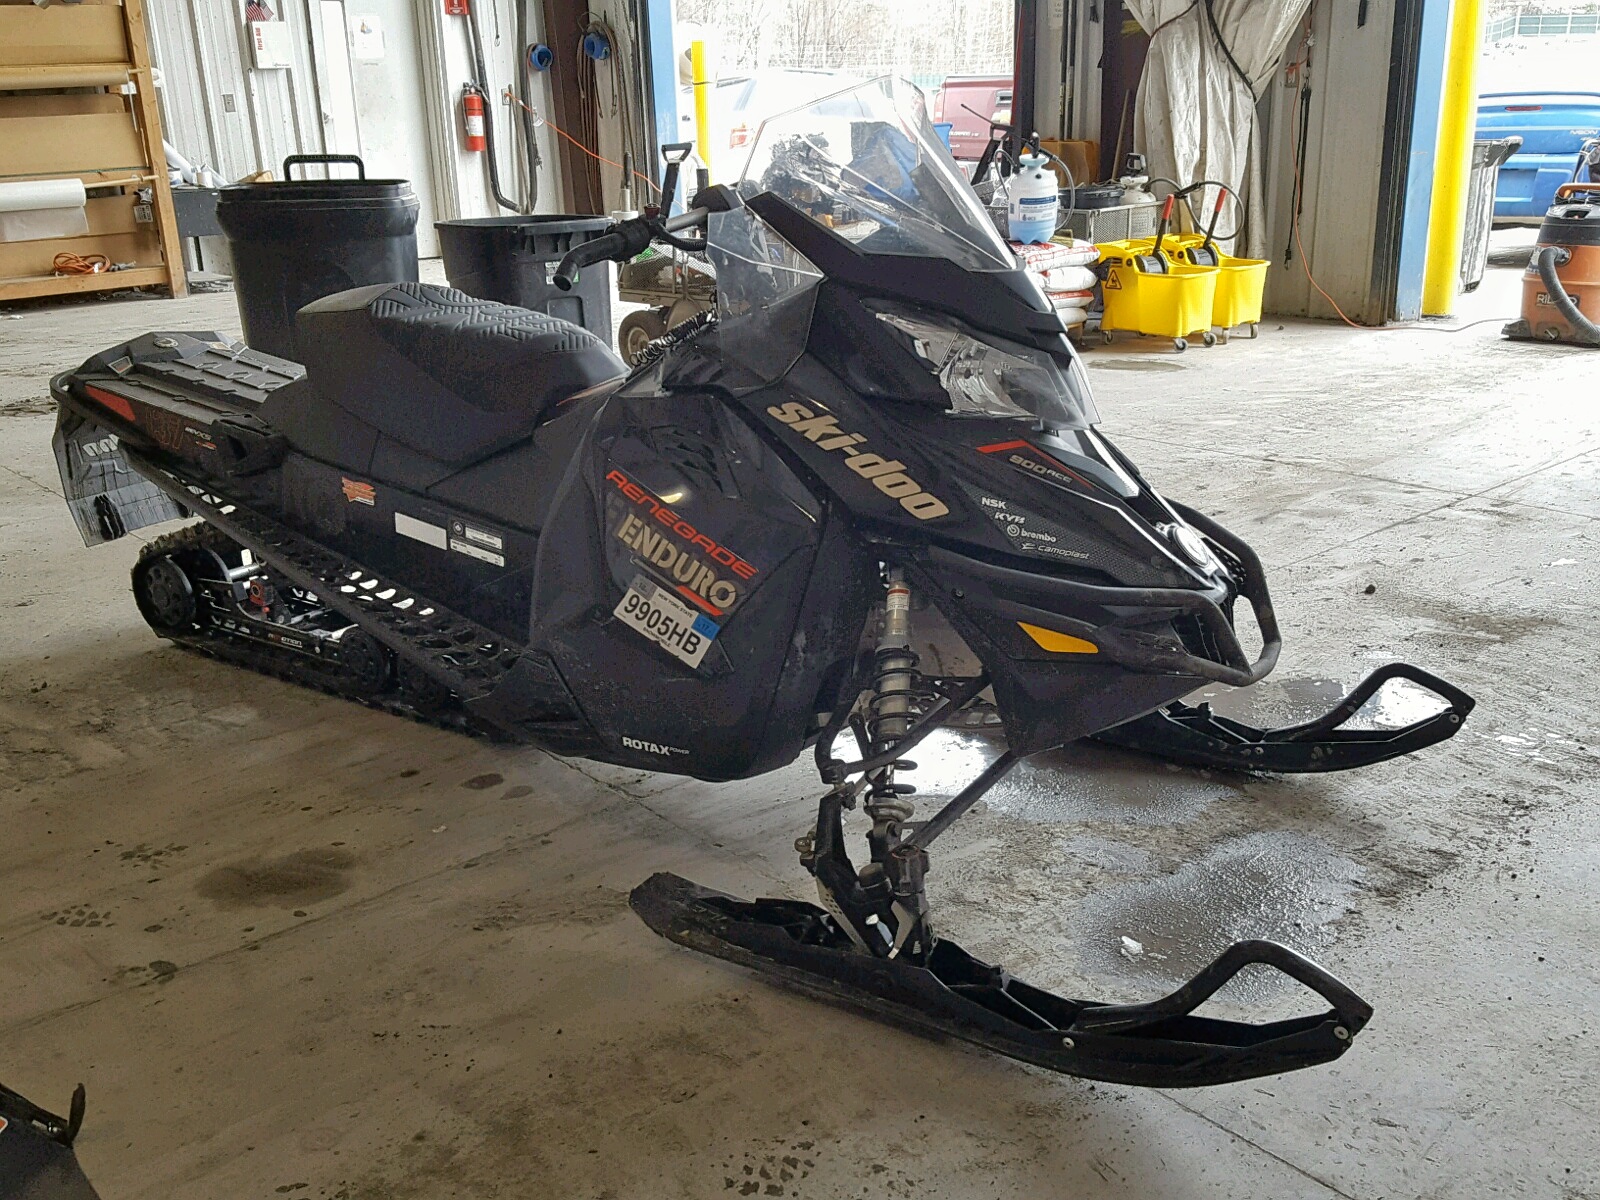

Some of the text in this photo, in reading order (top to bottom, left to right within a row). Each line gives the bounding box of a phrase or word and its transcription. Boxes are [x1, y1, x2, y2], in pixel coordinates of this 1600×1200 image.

[981, 496, 1007, 510] NSK
[605, 470, 758, 580] RENEGADE
[1021, 528, 1057, 543] brembo
[617, 513, 736, 608] ENDURO
[1037, 544, 1090, 560] camoplast
[658, 592, 693, 618] NEW YORK STATE
[624, 594, 701, 655] 9905HB
[702, 623, 710, 631] 17
[622, 736, 671, 756] ROTAX
